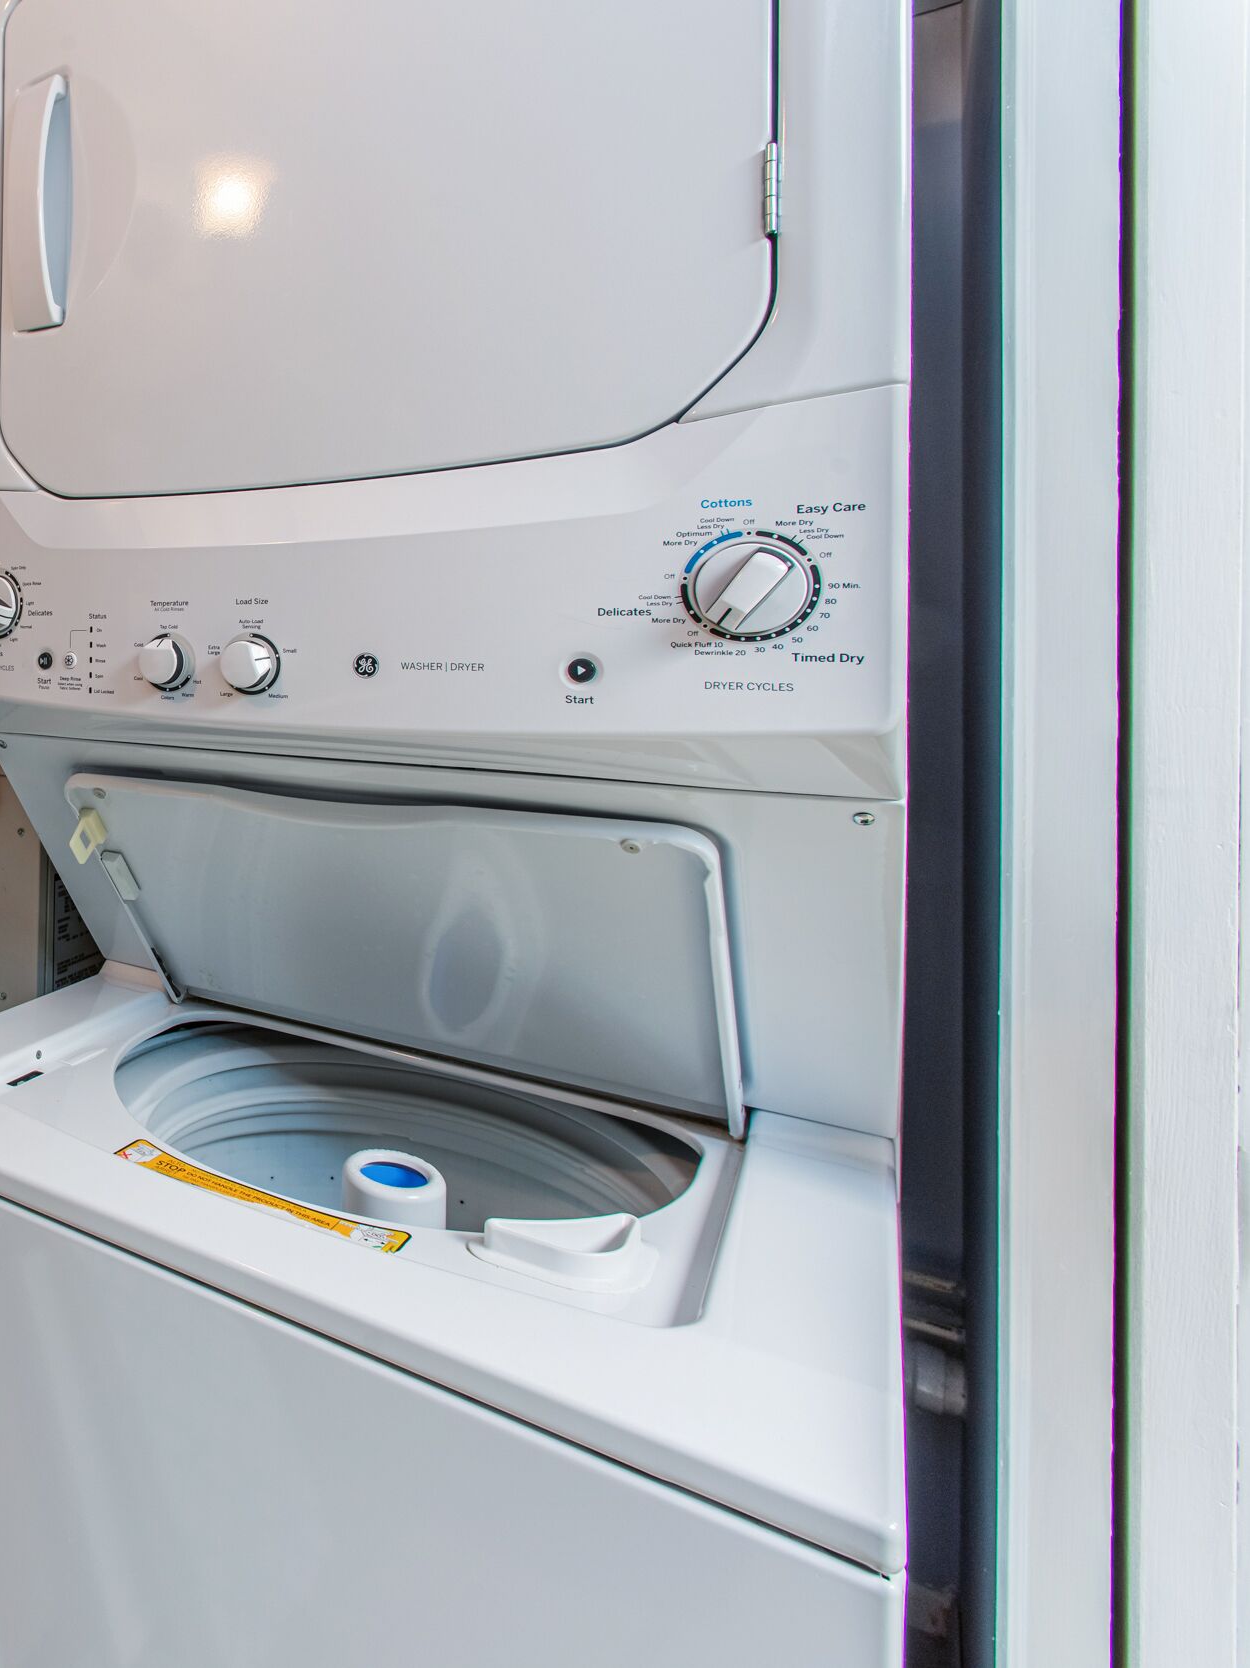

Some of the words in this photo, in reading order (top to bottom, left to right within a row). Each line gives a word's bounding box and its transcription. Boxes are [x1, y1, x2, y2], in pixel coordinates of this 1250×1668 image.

[700, 498, 753, 509] Cottons
[796, 504, 829, 516] Easy
[832, 502, 866, 512] Care
[743, 518, 755, 526] Off
[798, 519, 814, 527] Dry
[684, 539, 698, 547] Dry
[150, 600, 189, 608] Temperature
[597, 607, 652, 617] Delicates
[672, 617, 686, 625] Dry
[791, 652, 835, 663] Timed
[839, 653, 865, 665] Dry
[400, 662, 443, 671] WASHER
[450, 662, 485, 672] DRYER
[37, 677, 52, 685] Start
[704, 681, 743, 690] DRYER
[746, 682, 794, 692] CYCLES
[565, 694, 594, 705] Start
[156, 1160, 186, 1173] STOP
[211, 1181, 237, 1192] HANDLE
[253, 1196, 284, 1212] PRODUCT
[295, 1211, 310, 1219] THIS
[310, 1217, 330, 1227] AREA
